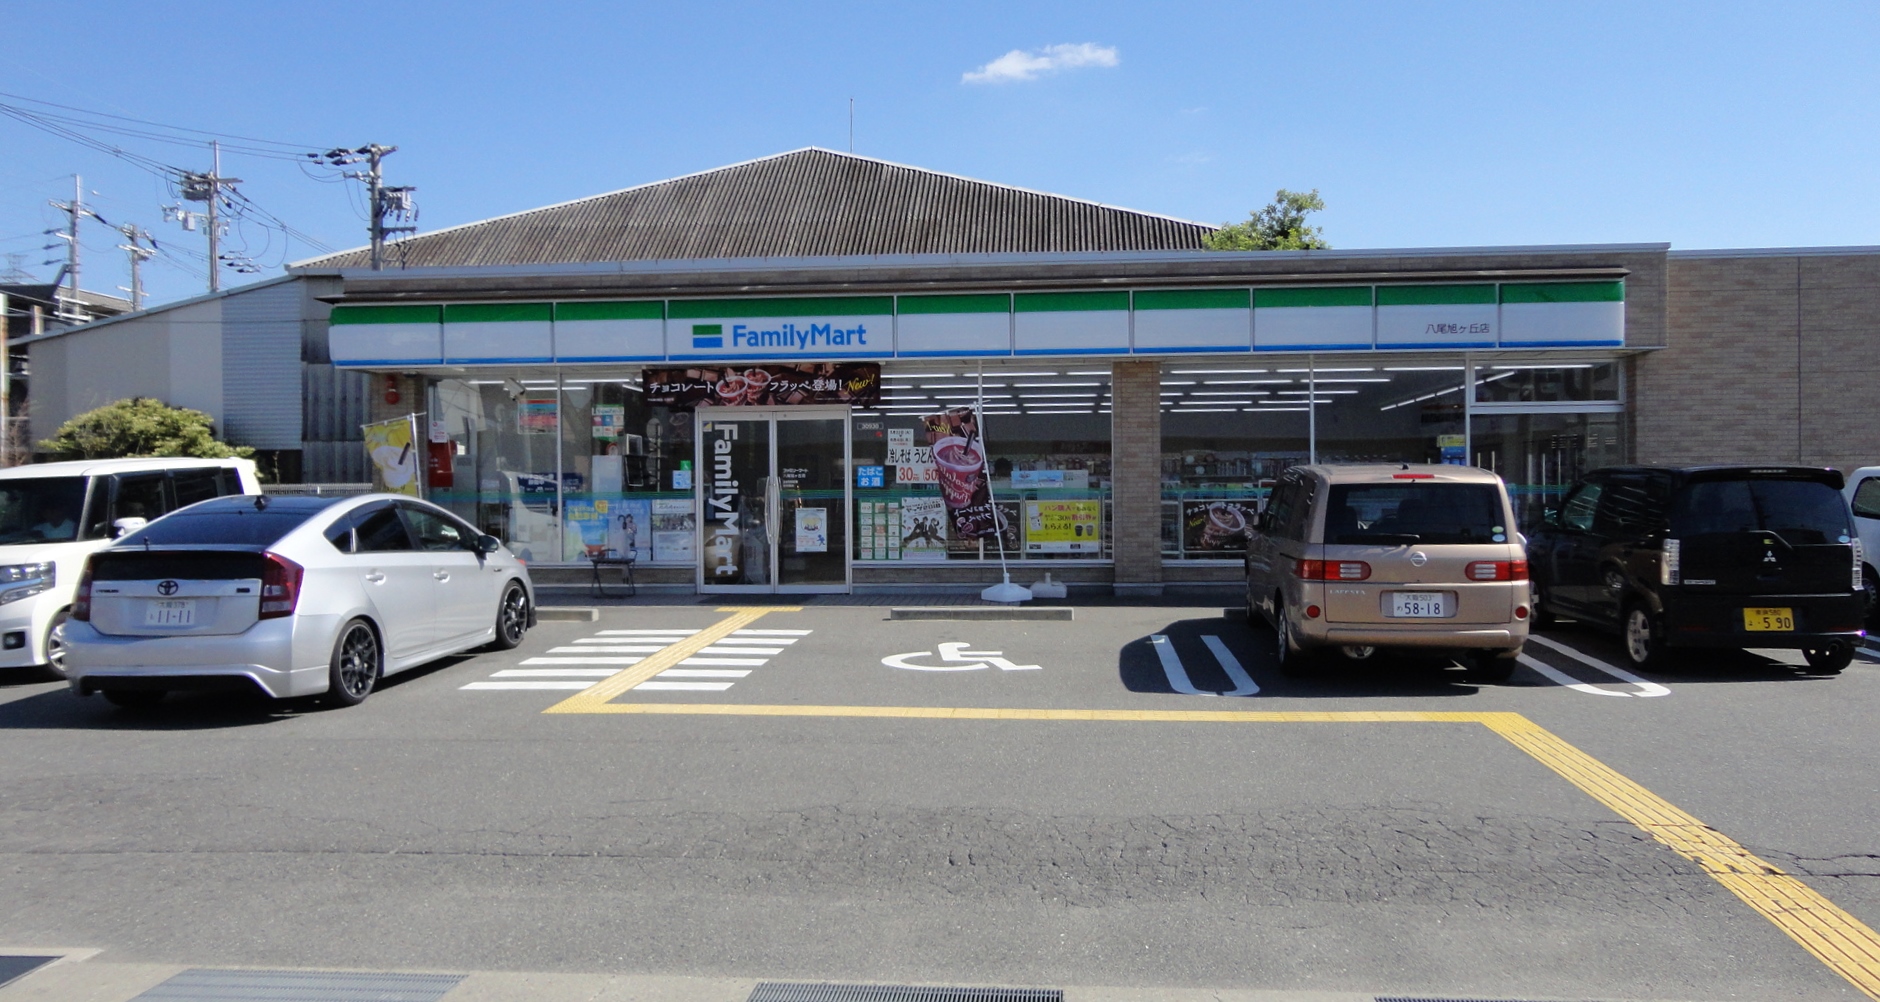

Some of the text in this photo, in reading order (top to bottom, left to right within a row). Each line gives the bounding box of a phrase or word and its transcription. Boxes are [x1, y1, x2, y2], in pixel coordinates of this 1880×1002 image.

[1425, 322, 1490, 335] 八尾旭ヶ丘店
[732, 323, 867, 350] FamilyMart
[649, 380, 715, 394] チョコレート
[844, 373, 876, 395] New!
[888, 448, 934, 464] 冷しそば うどん
[858, 467, 883, 476] たばこ
[860, 477, 881, 487] お酒
[708, 424, 739, 576] FamilyMart
[1404, 602, 1441, 615] 58-18
[157, 610, 191, 624] 11-11
